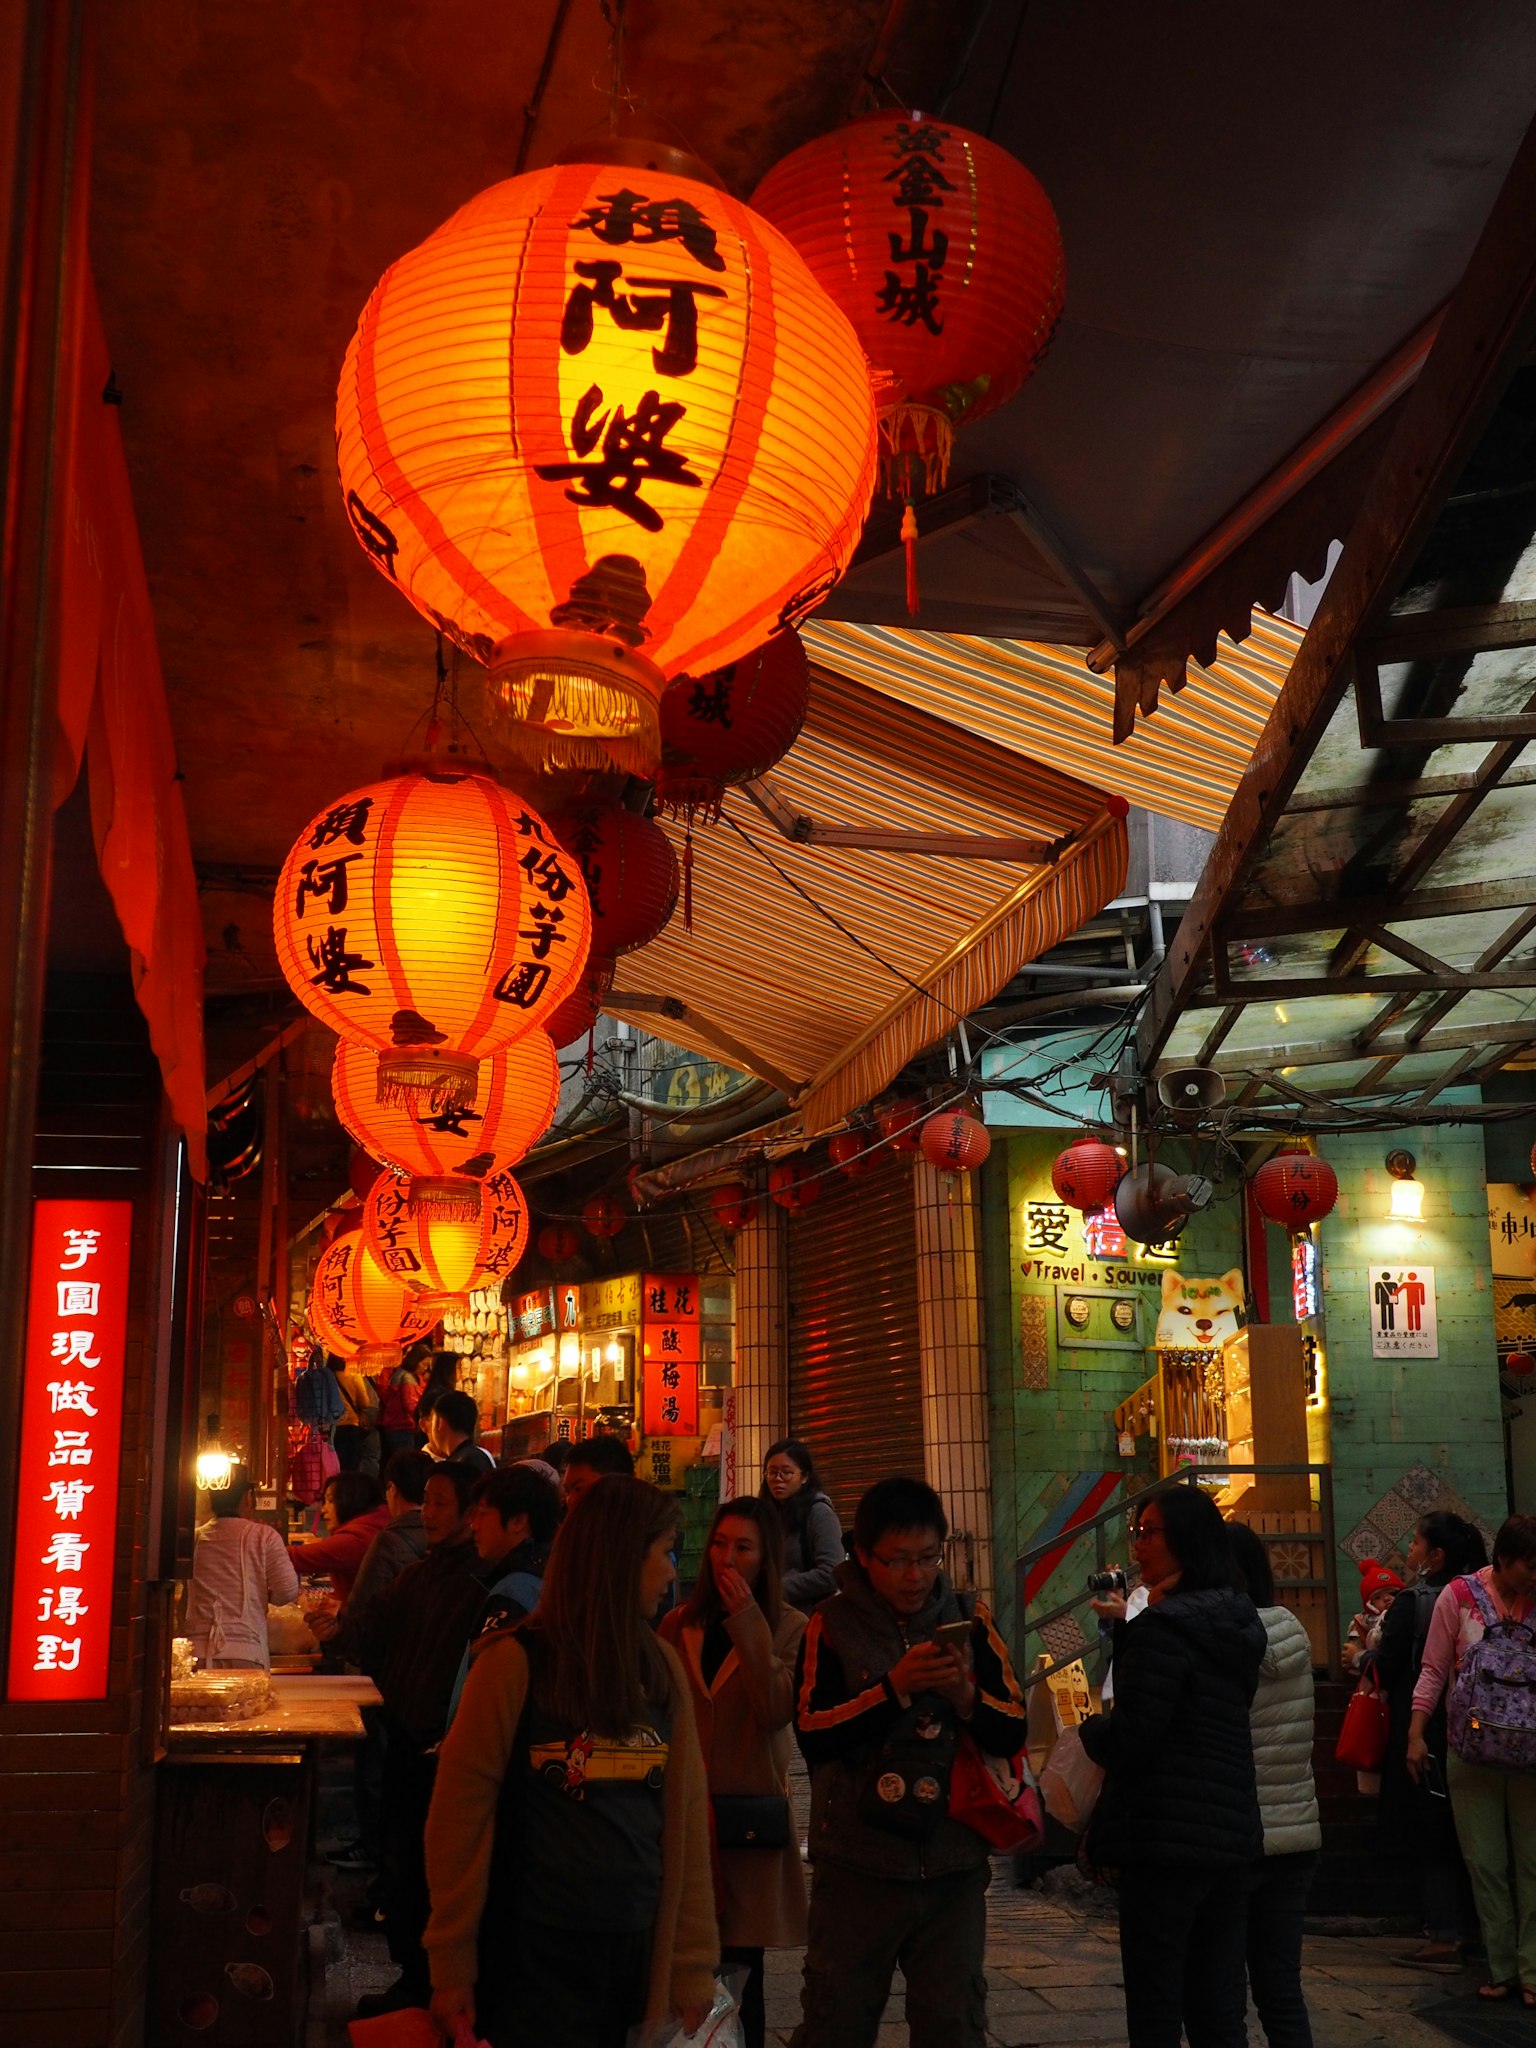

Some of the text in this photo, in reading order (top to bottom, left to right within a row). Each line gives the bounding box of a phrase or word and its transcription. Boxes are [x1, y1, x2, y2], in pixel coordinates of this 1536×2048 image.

[493, 810, 577, 1010] 九份芋圓
[1290, 1163, 1312, 1211] 九份
[376, 1172, 422, 1273] 九份芋圓
[1033, 1260, 1085, 1281] Travel
[651, 1286, 695, 1316] 桂花
[1376, 1341, 1431, 1350] ご注意ください
[661, 1327, 684, 1425] 酸梅湯
[32, 1228, 102, 1672] 芋圓現做品質看得到
[263, 1500, 271, 1508] 50
